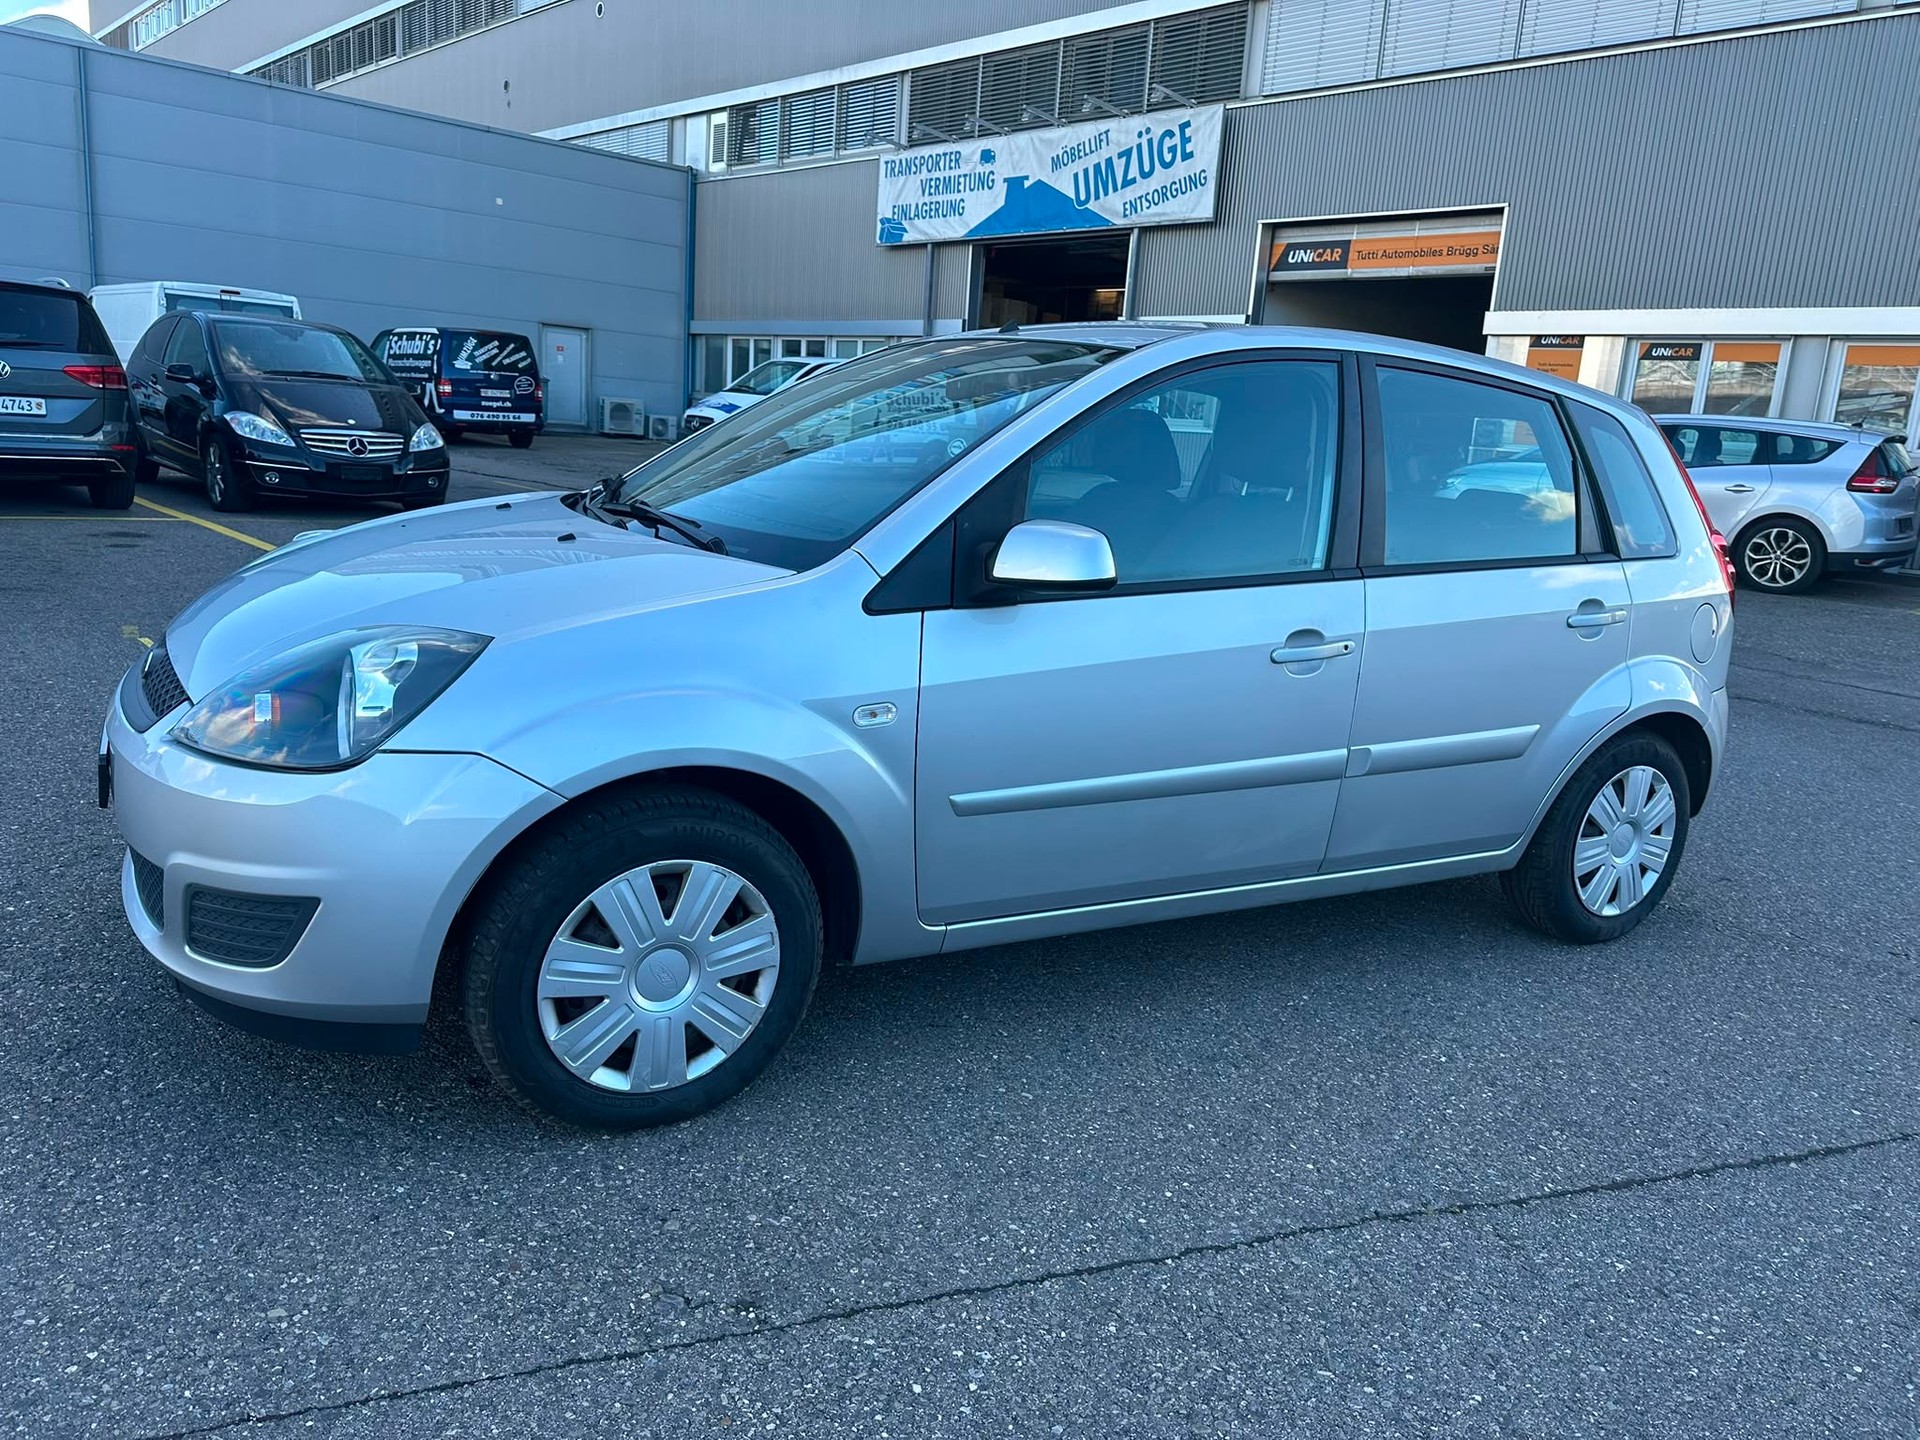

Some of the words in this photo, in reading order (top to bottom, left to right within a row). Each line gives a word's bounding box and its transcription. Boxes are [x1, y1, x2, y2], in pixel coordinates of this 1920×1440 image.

[1050, 129, 1111, 173] MÖBELLIFT
[1073, 120, 1195, 208] UMZÜGE
[884, 151, 962, 179] TRANSPORTER
[920, 171, 995, 197] VERMIETUNG
[1122, 169, 1208, 219] ENTSORGUNG
[892, 198, 965, 222] EINLAGERUNG
[1356, 250, 1379, 261] Tutti
[1380, 247, 1443, 260] Automobiles
[1446, 245, 1479, 257] Brügg
[1, 399, 33, 412] 4743
